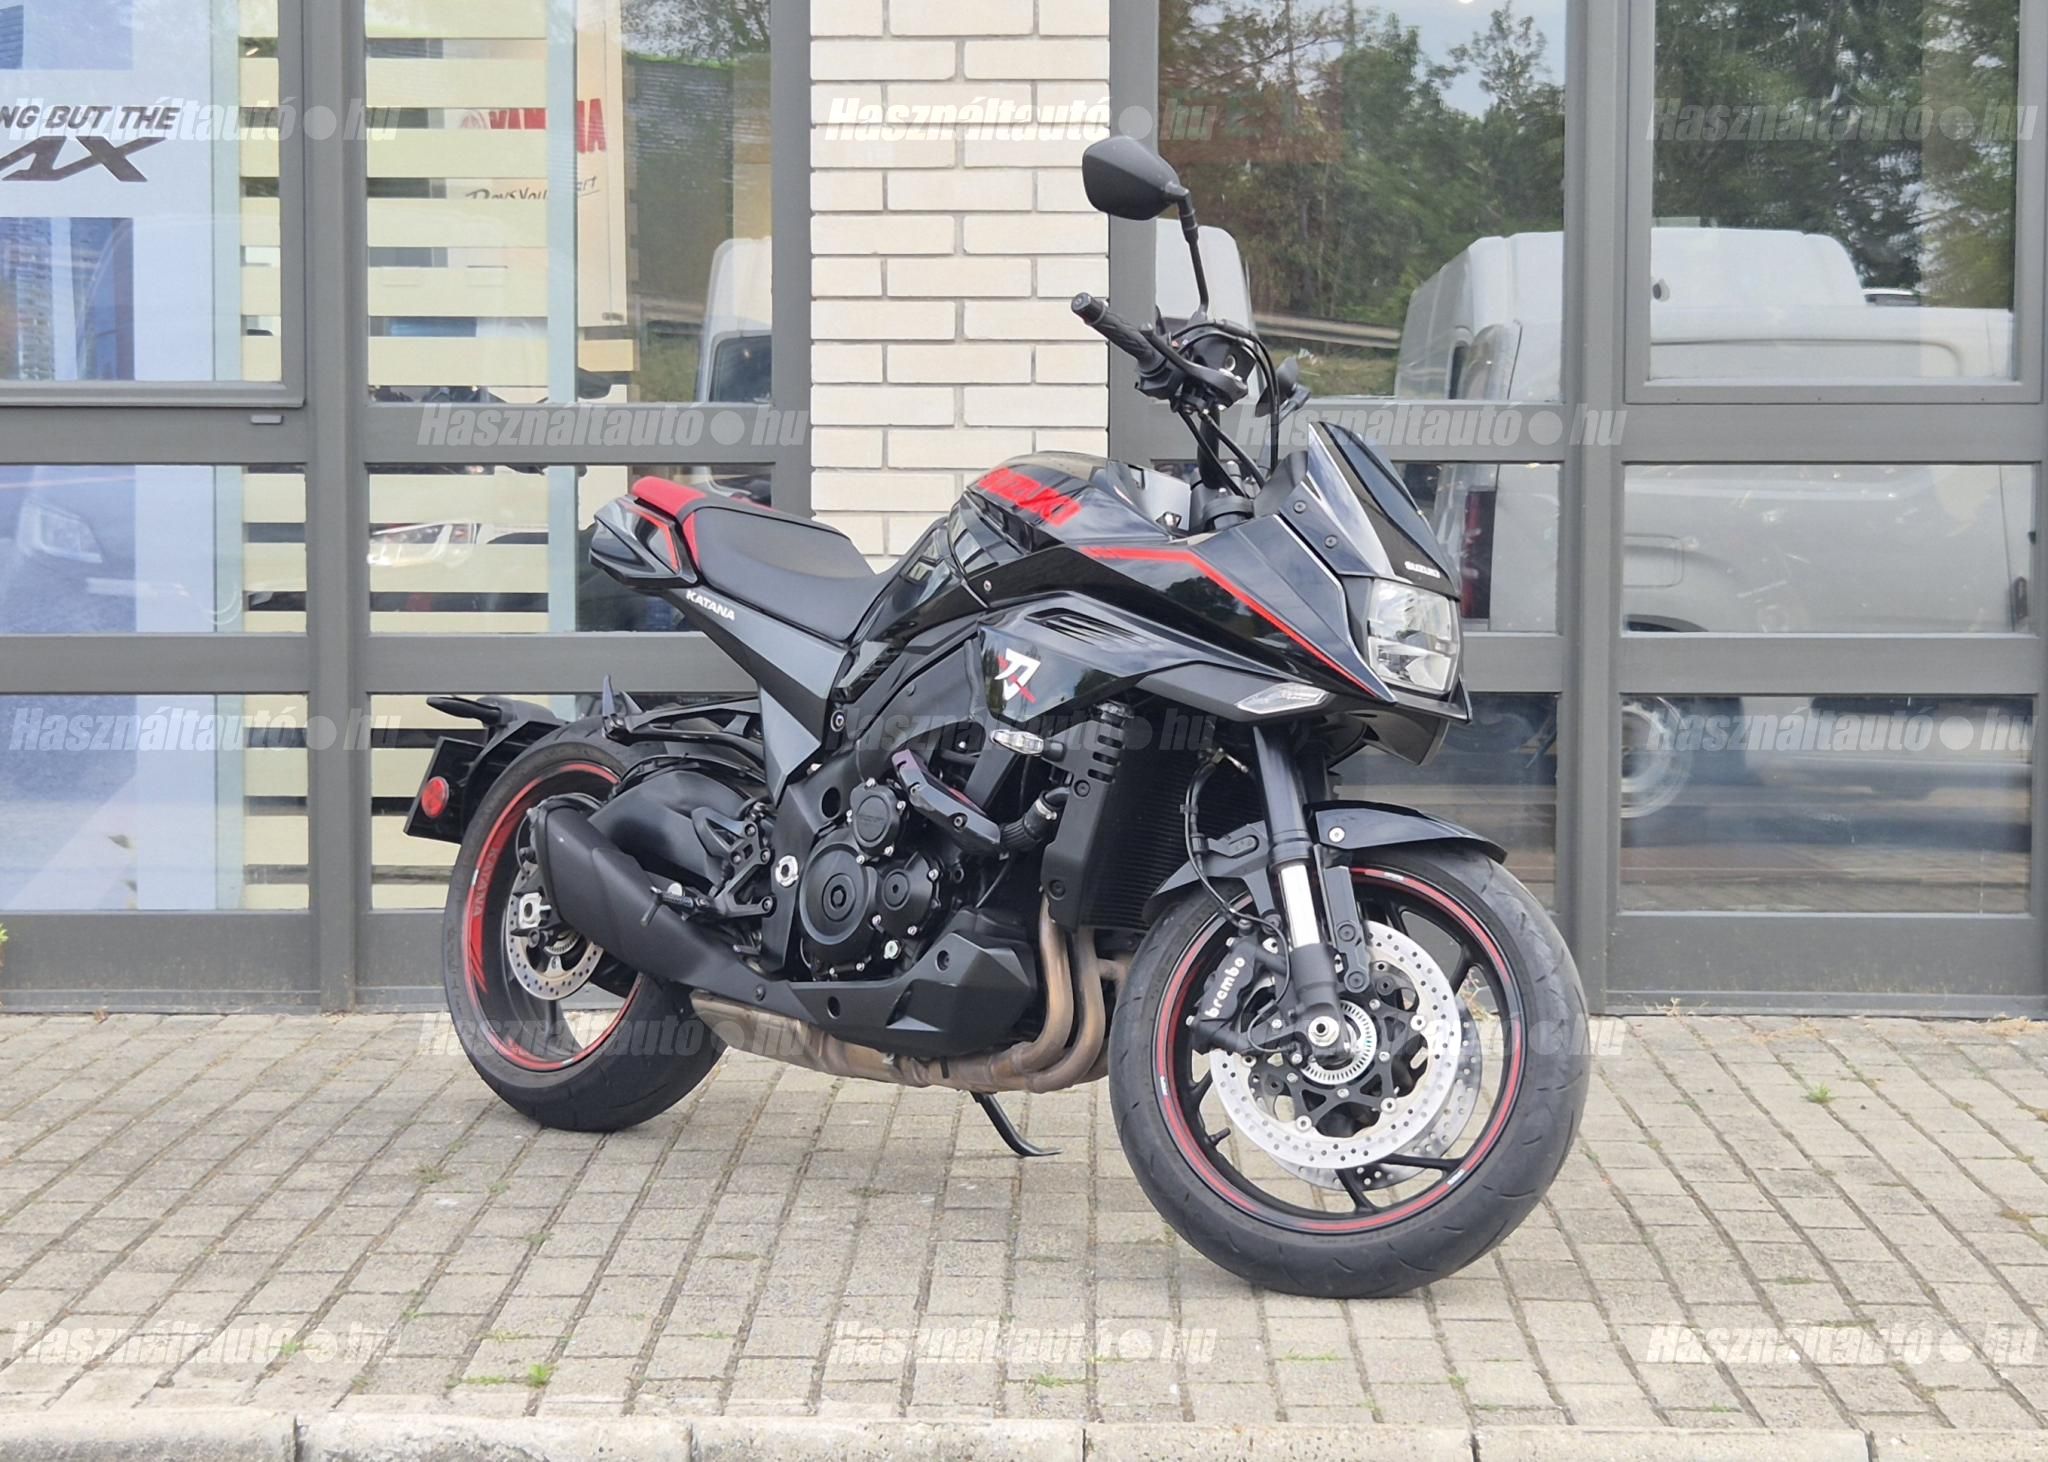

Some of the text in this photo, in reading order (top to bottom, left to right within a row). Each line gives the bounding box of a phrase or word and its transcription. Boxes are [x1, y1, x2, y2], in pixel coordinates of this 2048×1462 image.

[45, 106, 113, 129] BUT
[118, 106, 181, 130] THE
[686, 589, 736, 621] KATANA
[473, 846, 501, 917] KATANA
[1204, 957, 1245, 1018] brembo
